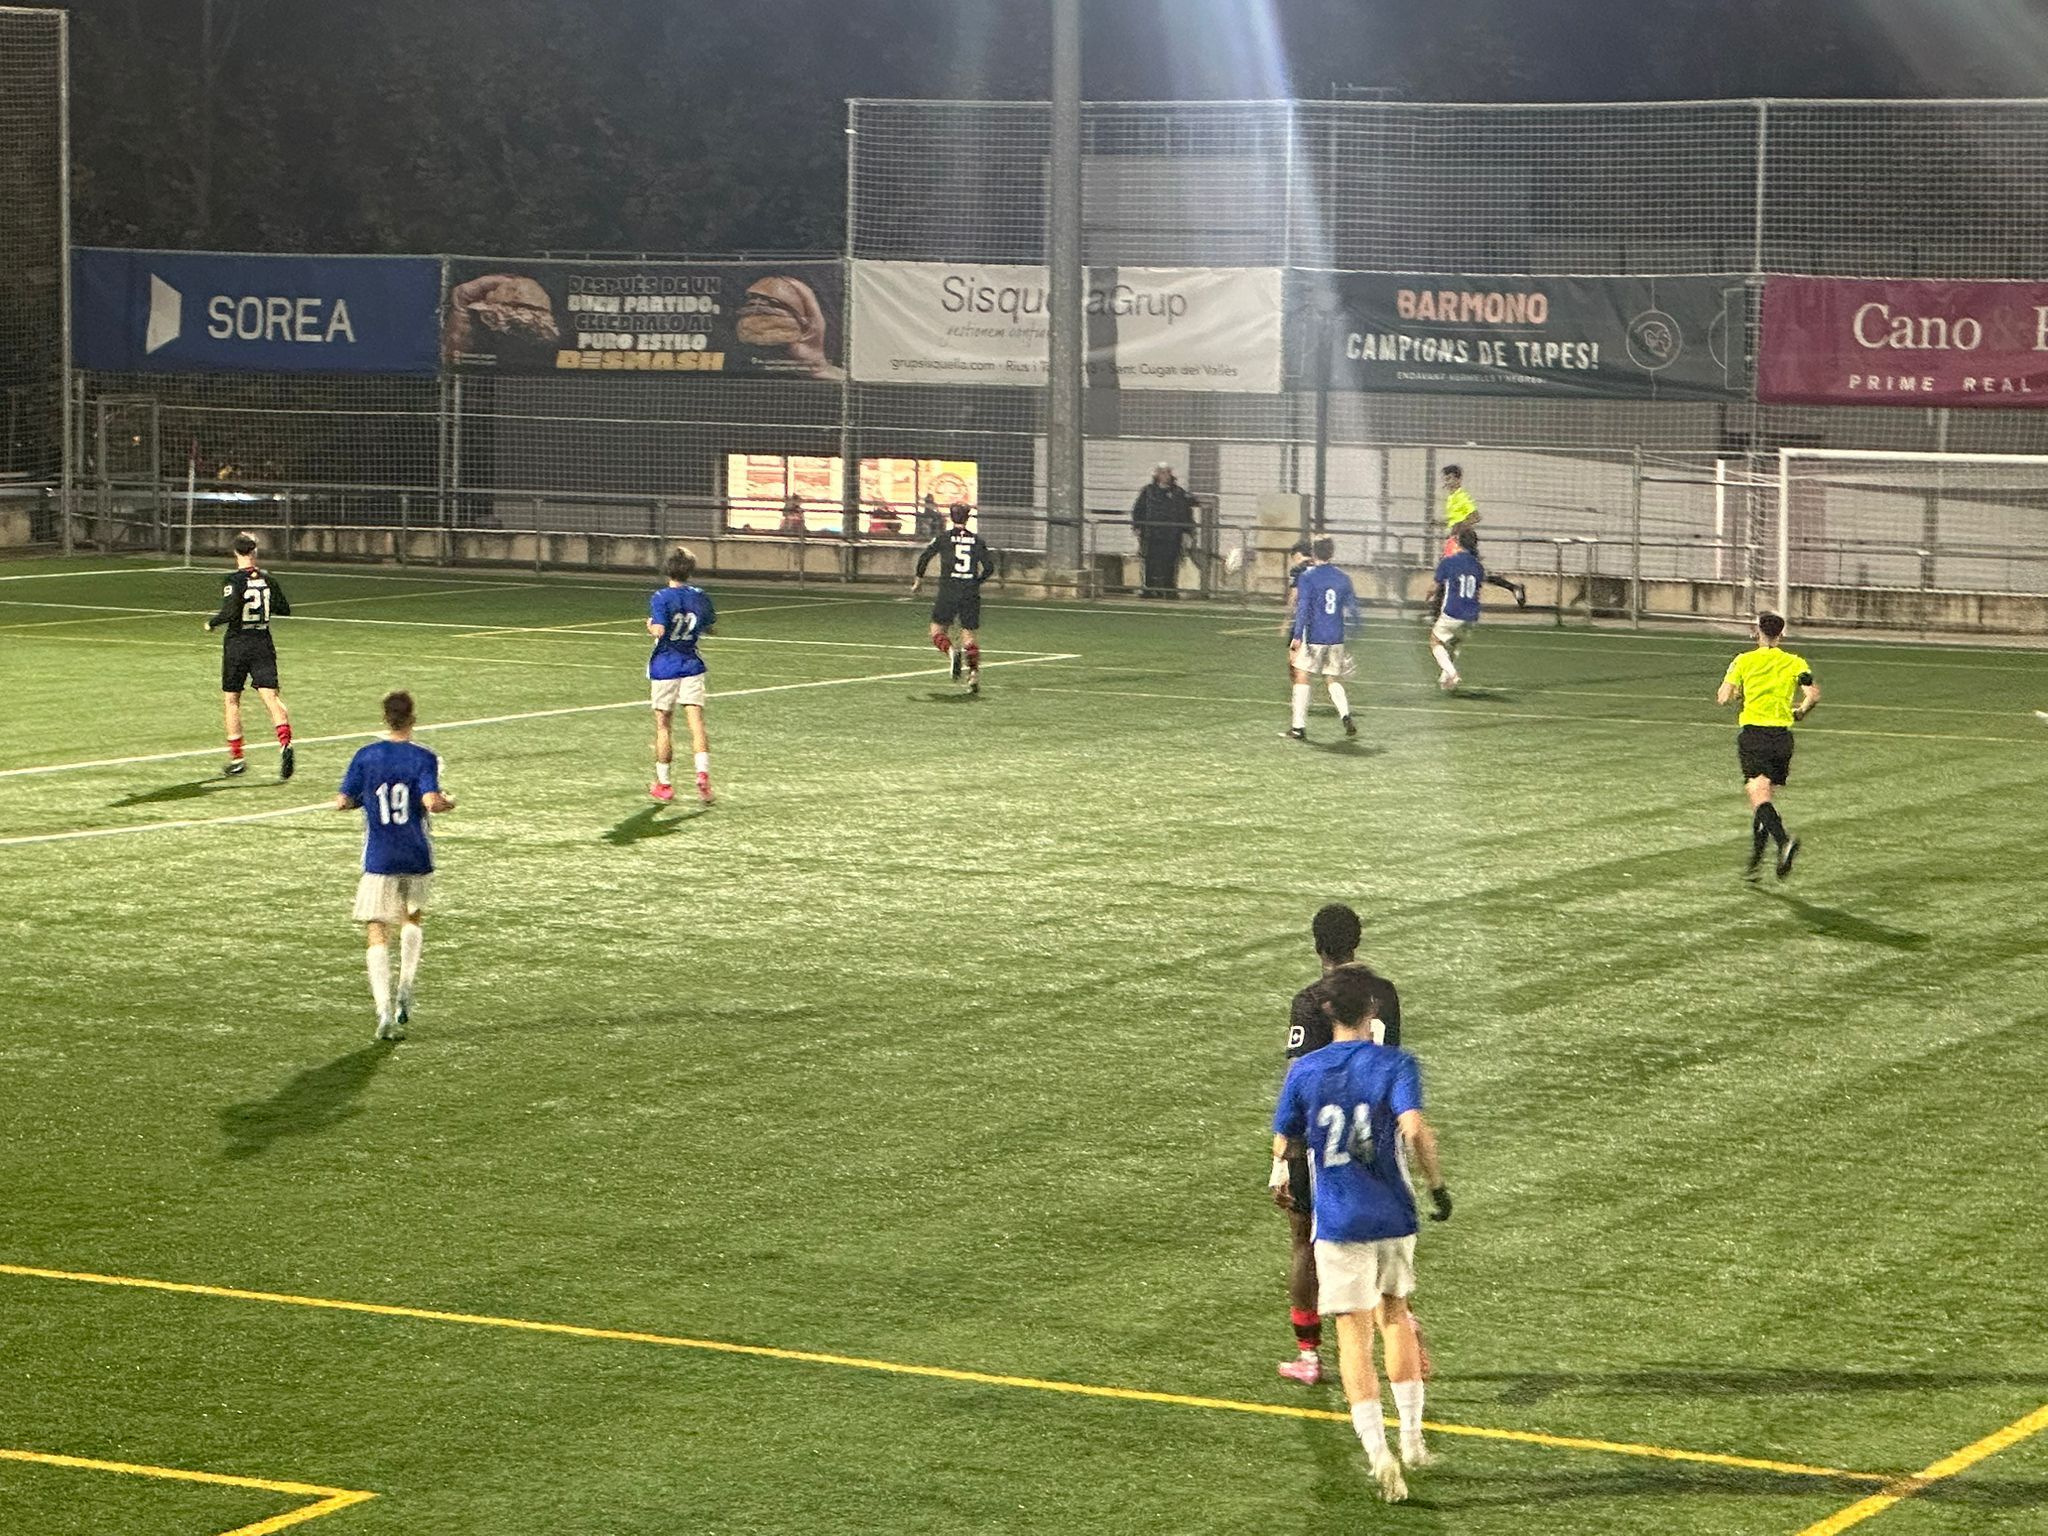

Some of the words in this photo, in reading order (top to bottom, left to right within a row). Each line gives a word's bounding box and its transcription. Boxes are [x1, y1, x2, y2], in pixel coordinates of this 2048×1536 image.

[662, 276, 689, 294] DE
[691, 276, 722, 295] UN
[567, 294, 621, 312] BUEN
[1397, 290, 1548, 324] BARMONO
[207, 295, 357, 343] SOREA
[687, 315, 713, 333] AL
[1853, 302, 1983, 351] Cano
[577, 332, 634, 350] PURO
[636, 333, 708, 351] ESTILO
[1347, 333, 1469, 363] CAMPIONS
[1478, 341, 1508, 366] DE
[1515, 342, 1600, 369] TAPES!
[1139, 363, 1177, 378] Cugat
[1848, 374, 1935, 392] PRIME
[1962, 376, 2032, 393] REAL
[954, 544, 971, 573] 5
[1459, 573, 1477, 599] 10
[242, 587, 271, 622] 21
[1325, 588, 1336, 615] 8
[669, 612, 698, 641] 22
[375, 782, 410, 825] 19
